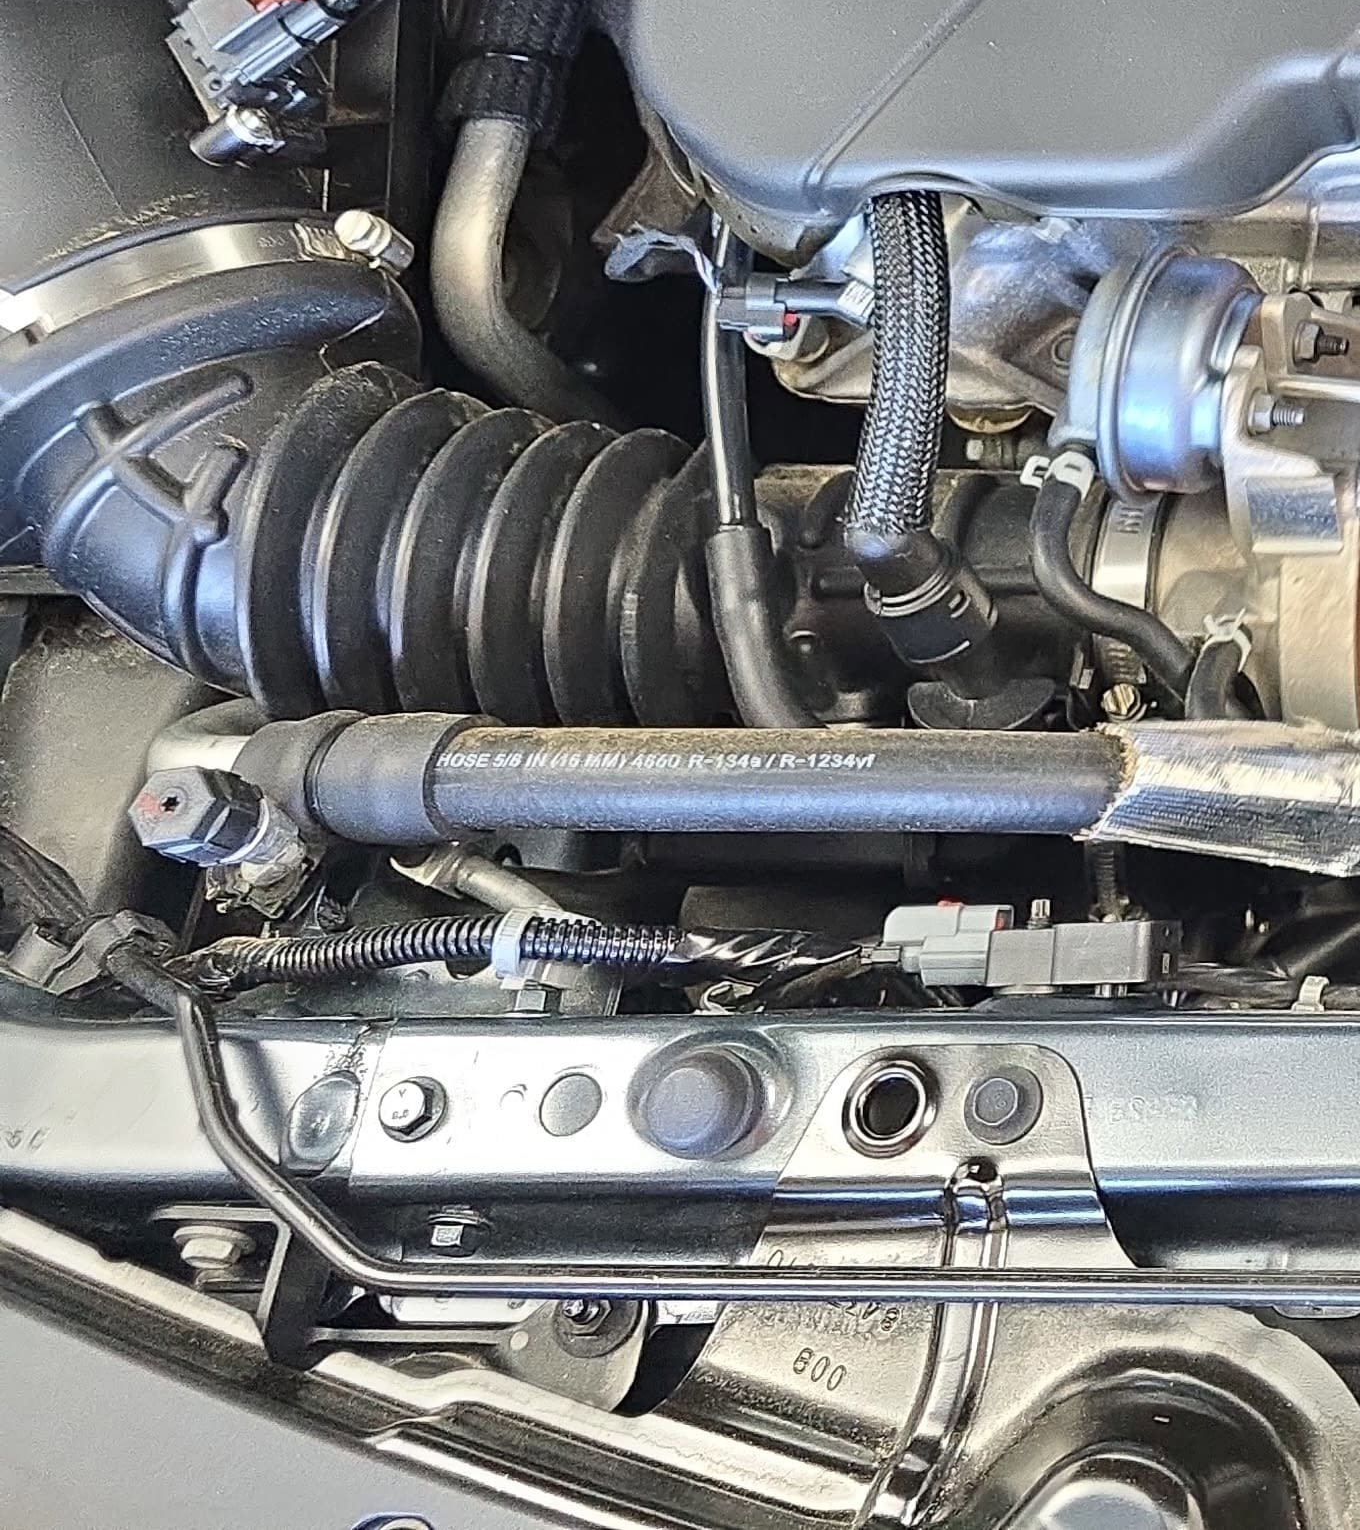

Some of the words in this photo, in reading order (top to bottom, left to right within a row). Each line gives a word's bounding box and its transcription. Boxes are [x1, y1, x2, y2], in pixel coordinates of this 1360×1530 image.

[435, 753, 491, 768] HOSE
[525, 753, 547, 768] IN
[687, 753, 762, 769] R-134a
[778, 753, 876, 770] R-1234yf
